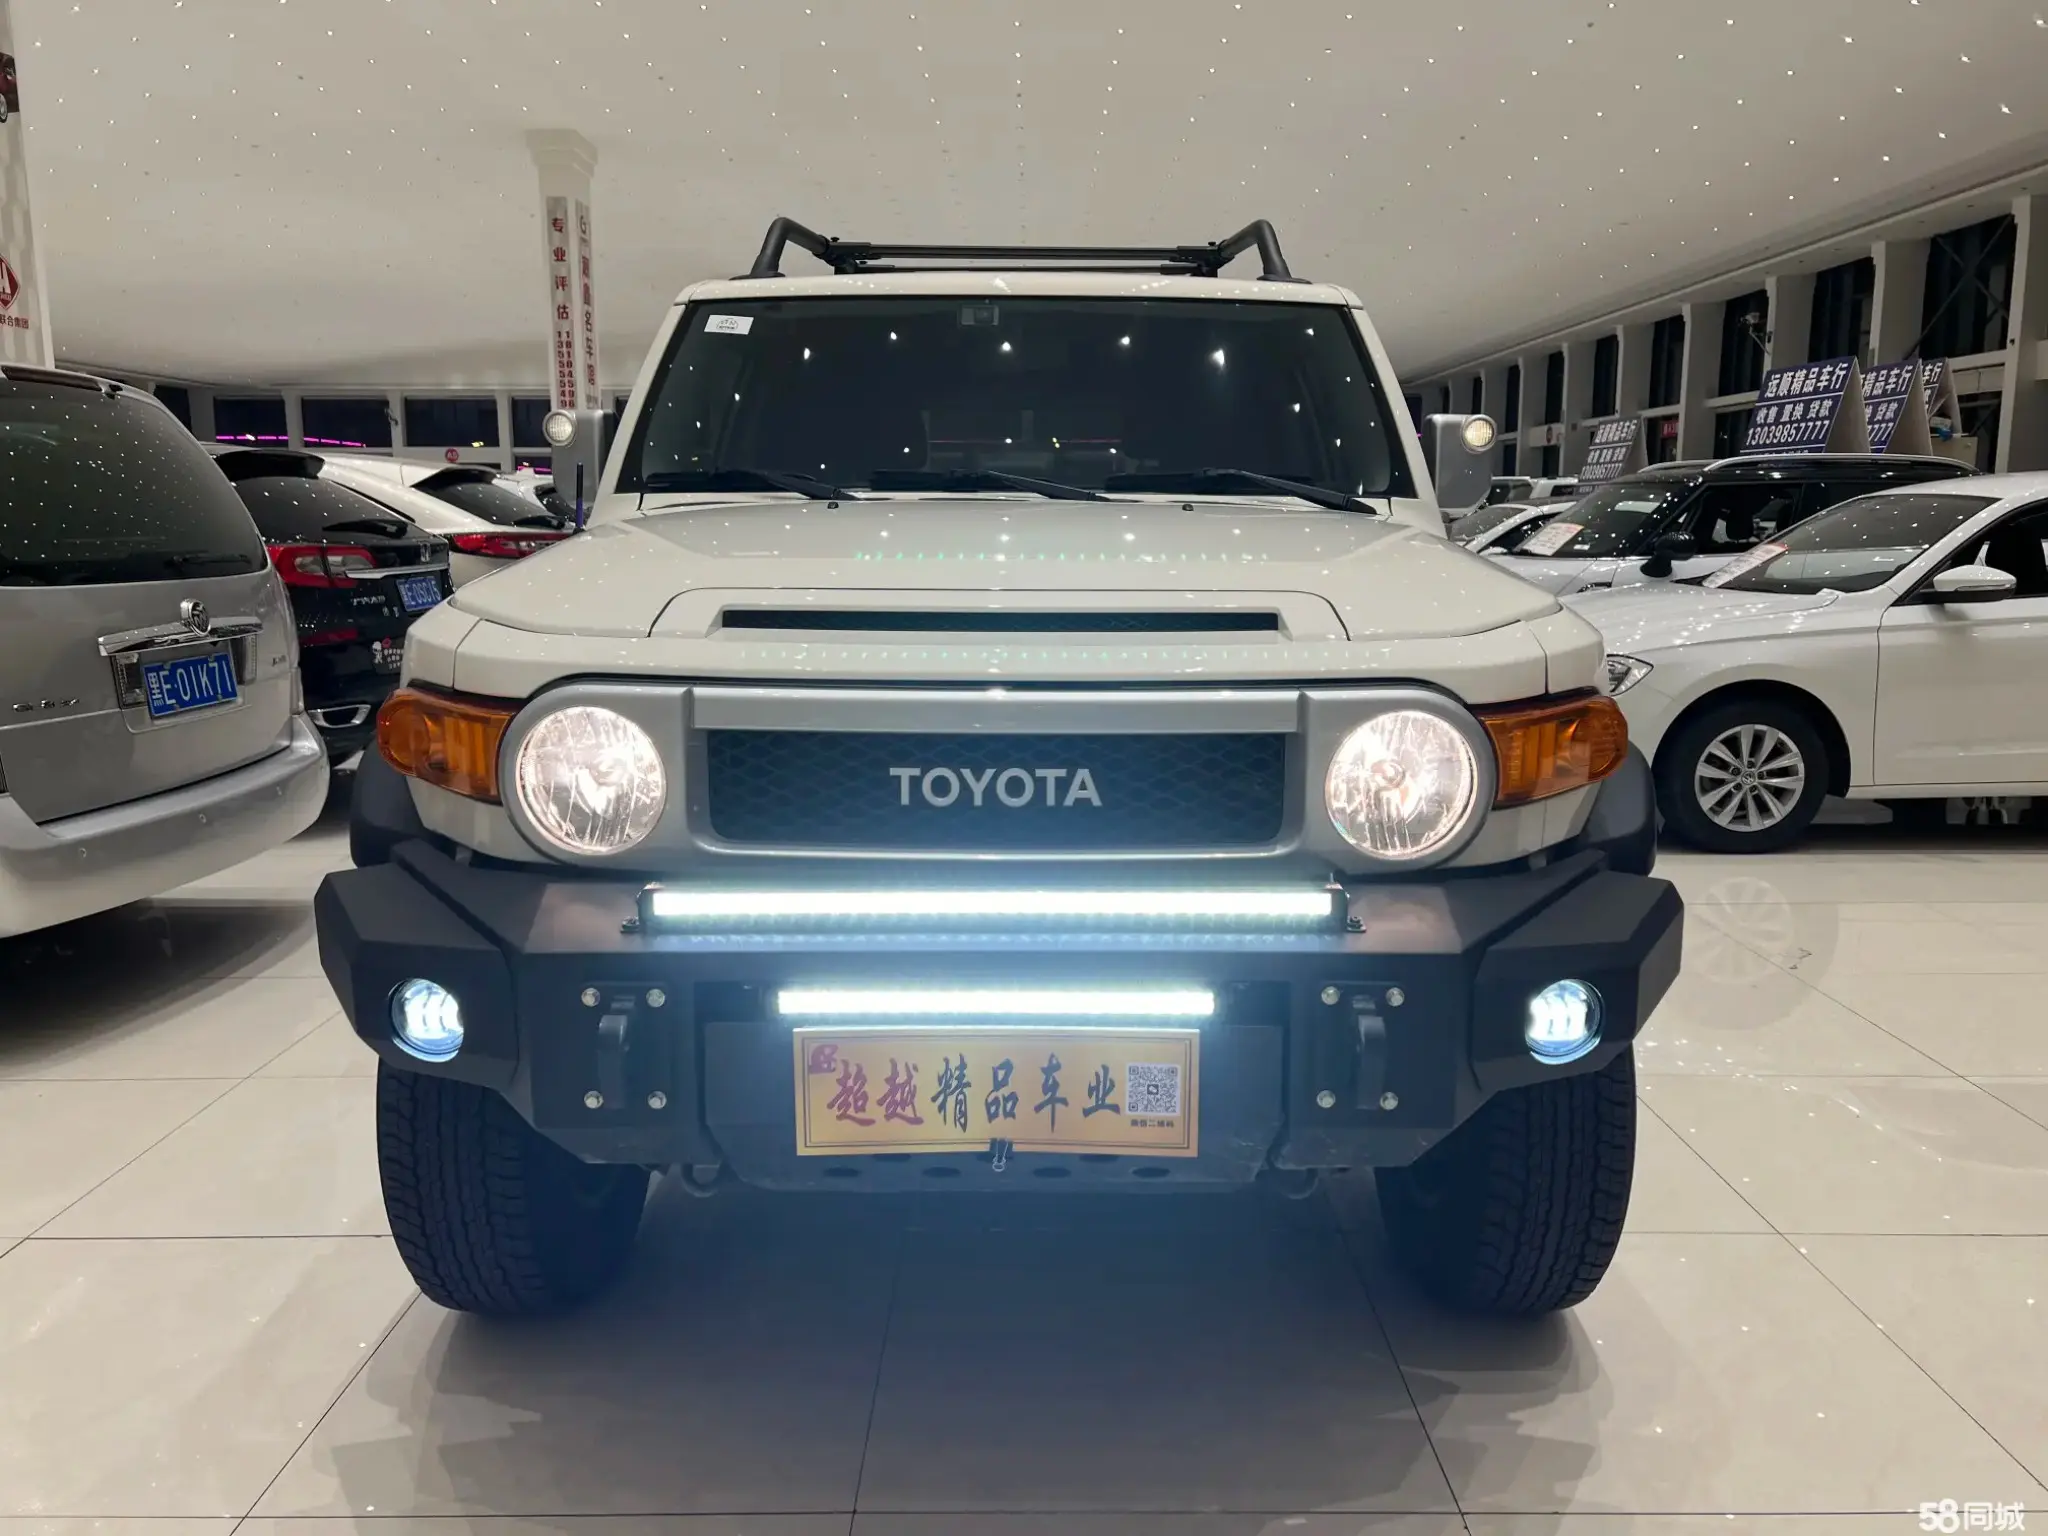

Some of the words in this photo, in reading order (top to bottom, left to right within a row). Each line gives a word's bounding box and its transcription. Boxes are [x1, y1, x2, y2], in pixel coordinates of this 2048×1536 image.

[551, 217, 570, 320] 专业评估
[1764, 362, 1849, 398] 远顺精品车行
[1859, 364, 1913, 396] 精品车行
[1756, 404, 1778, 424] 收售
[1780, 401, 1803, 423] 置换
[1807, 399, 1833, 419] 贷款
[1874, 401, 1899, 421] 贷款
[1746, 420, 1830, 446] 13039857777
[889, 767, 1103, 807] TOYOTA
[826, 1052, 1121, 1133] 超越精品车业
